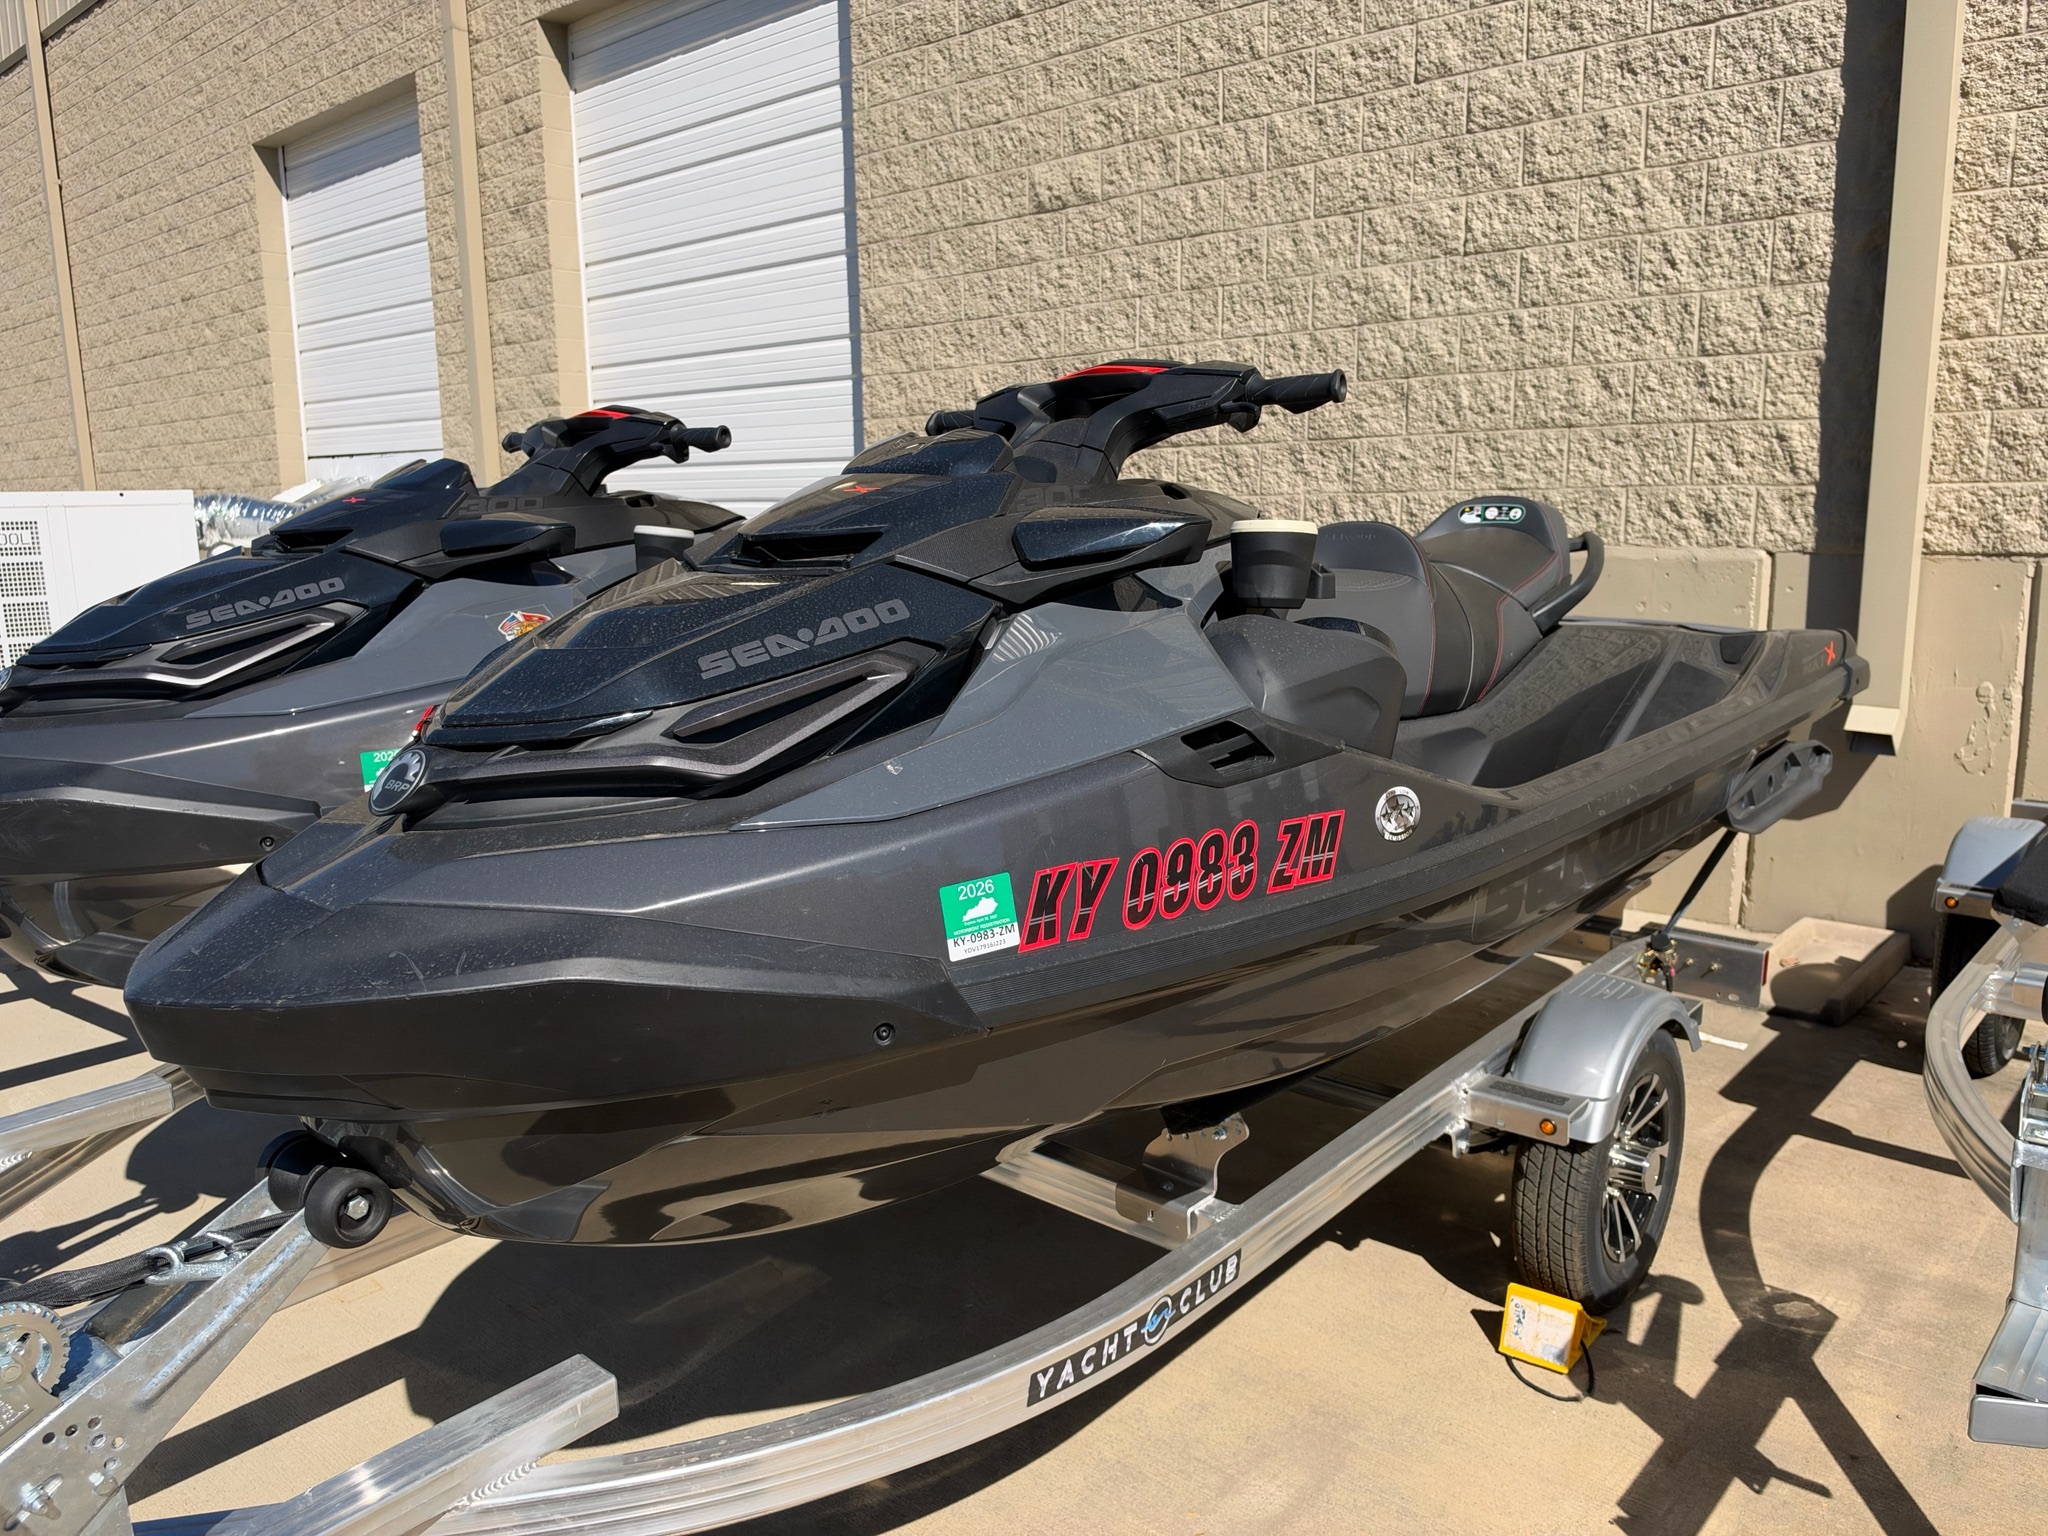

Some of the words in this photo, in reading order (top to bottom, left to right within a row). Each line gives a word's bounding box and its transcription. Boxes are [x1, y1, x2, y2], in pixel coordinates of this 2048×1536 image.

[384, 780, 411, 792] BRP
[958, 879, 995, 901] 2026
[1018, 857, 1120, 953] KY
[1122, 819, 1259, 931] 0983
[1266, 809, 1346, 894] ZM
[953, 923, 1016, 948] KY-0983-ZM
[1036, 1322, 1138, 1399] YACHT
[1179, 1254, 1239, 1315] CLUB
